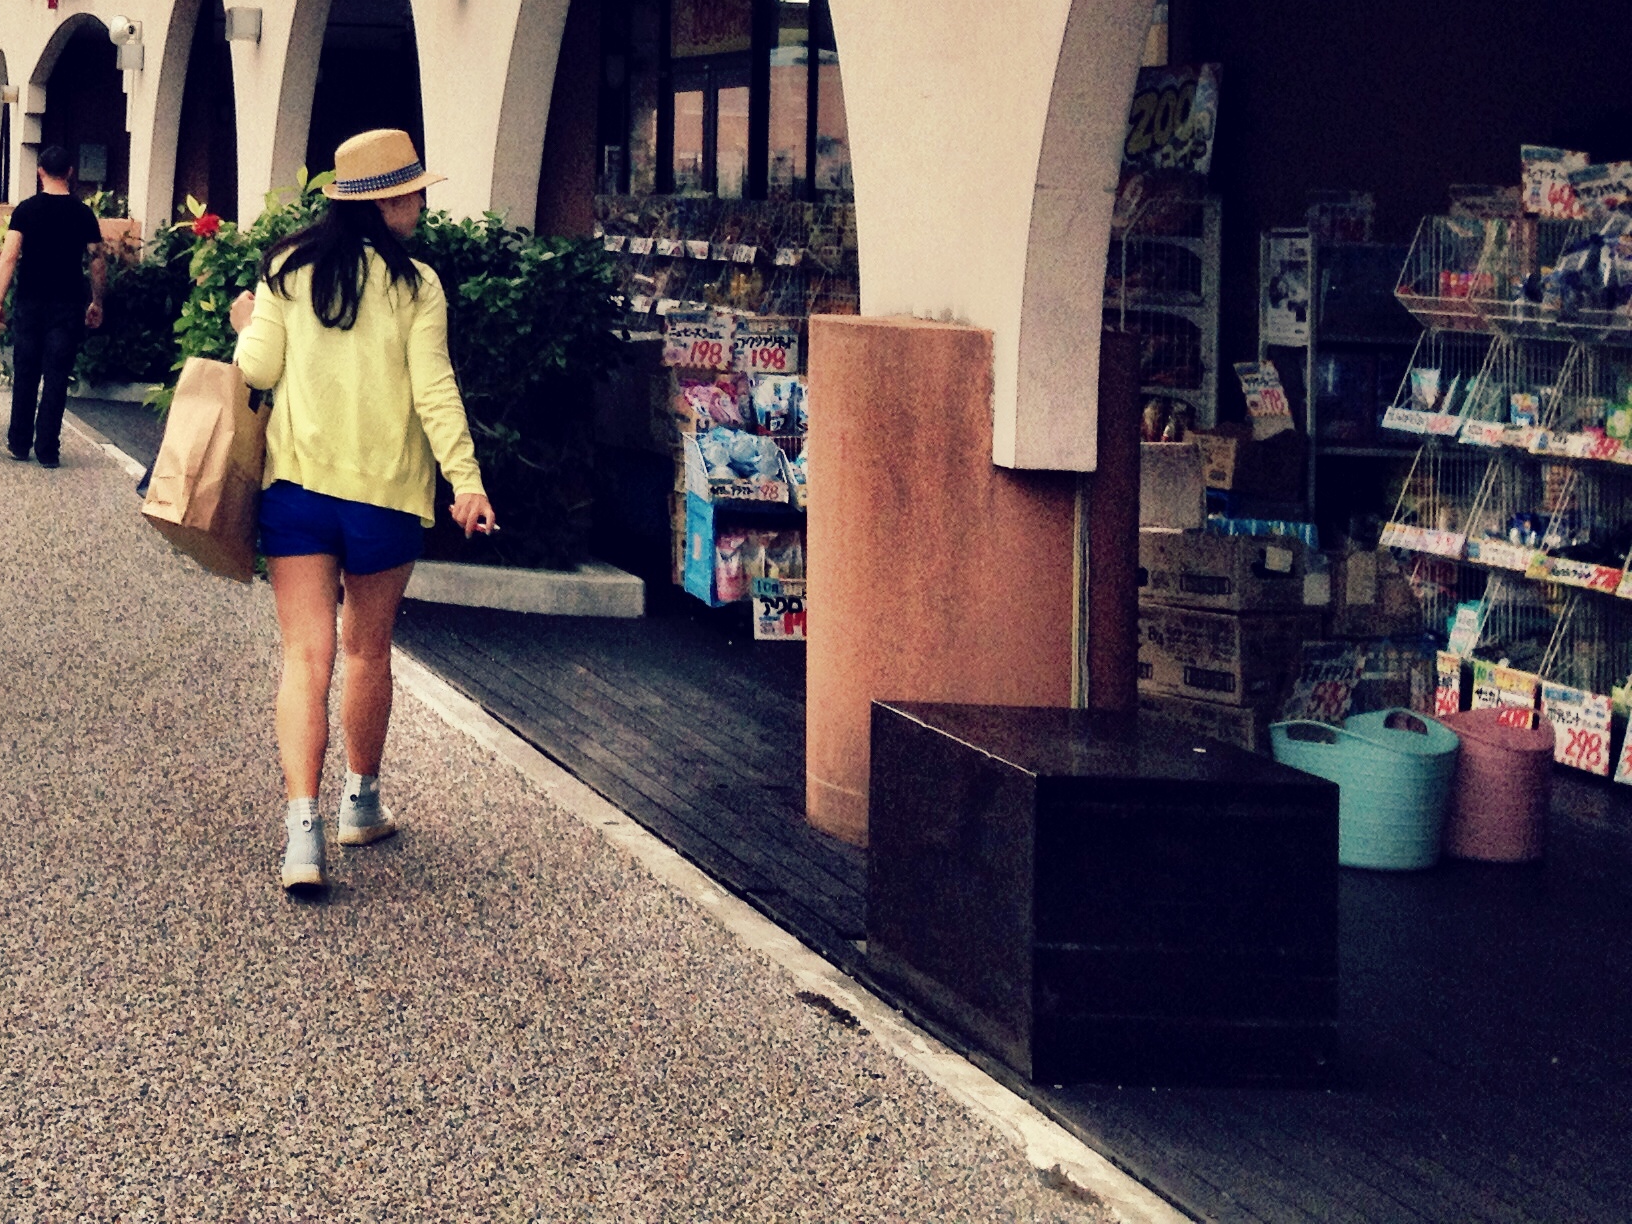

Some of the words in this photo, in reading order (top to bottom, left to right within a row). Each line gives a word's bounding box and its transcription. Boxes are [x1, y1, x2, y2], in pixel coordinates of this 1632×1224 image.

[689, 340, 723, 366] 198
[751, 347, 786, 370] 198
[1564, 727, 1602, 767] 298
